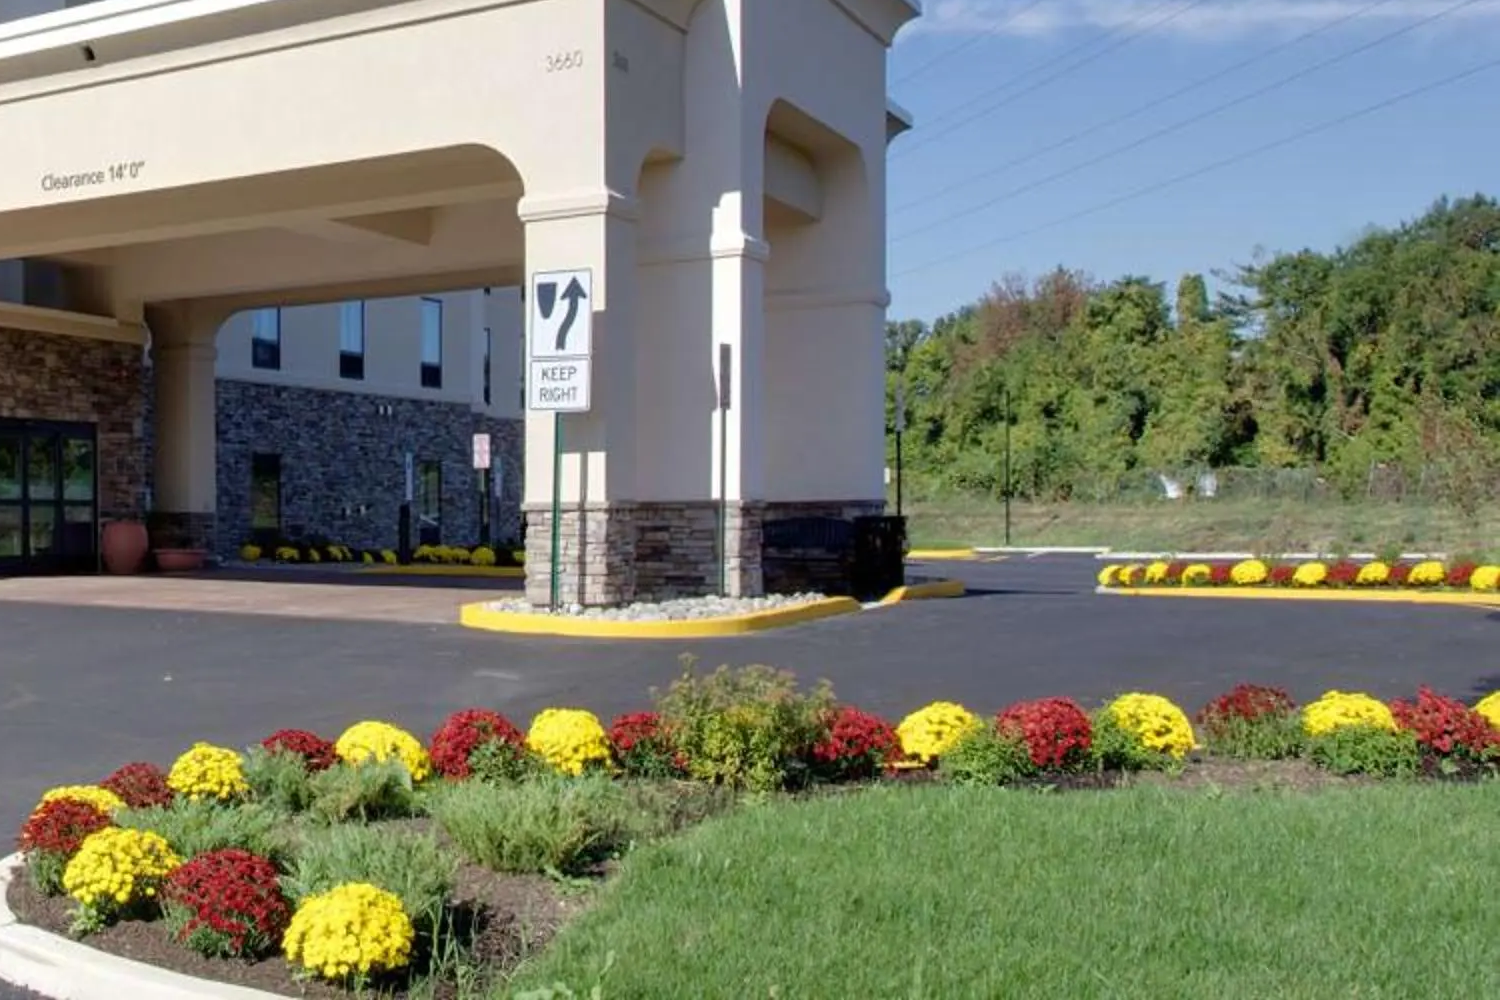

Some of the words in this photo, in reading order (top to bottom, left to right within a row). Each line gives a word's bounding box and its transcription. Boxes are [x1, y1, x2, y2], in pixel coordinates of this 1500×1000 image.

[41, 169, 105, 191] Clearance
[541, 366, 578, 382] KEEP
[539, 386, 578, 403] RIGHT
